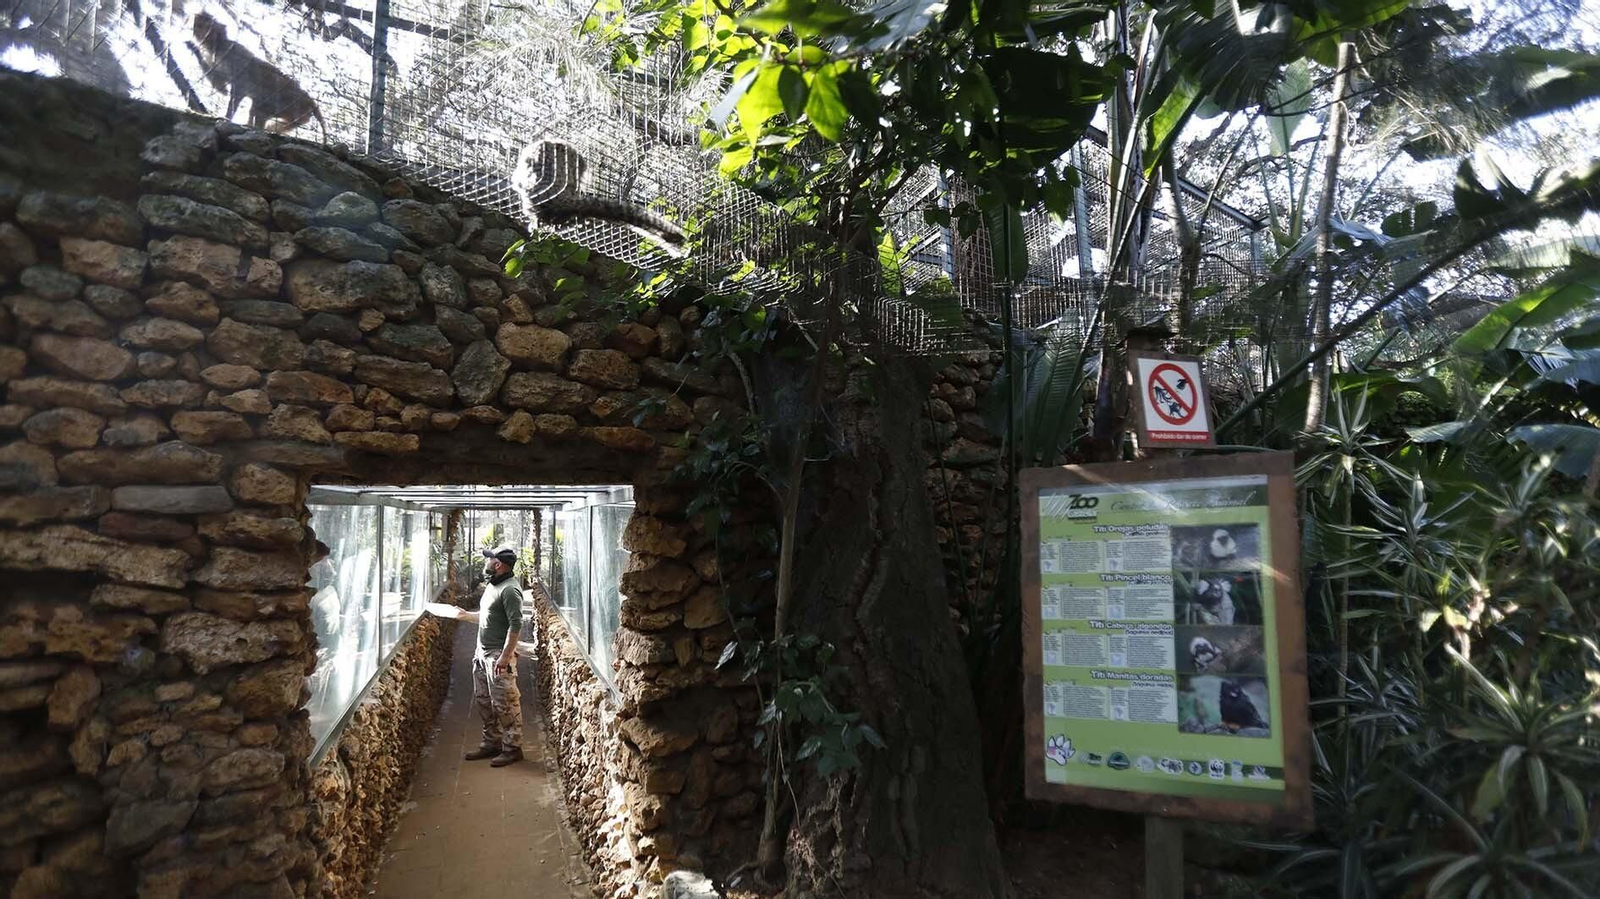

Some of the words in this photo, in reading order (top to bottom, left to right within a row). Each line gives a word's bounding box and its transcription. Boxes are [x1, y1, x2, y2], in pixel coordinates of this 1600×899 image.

[1115, 573, 1140, 582] Pincel
[1142, 572, 1171, 581] blanco
[1107, 671, 1139, 681] Manitas
